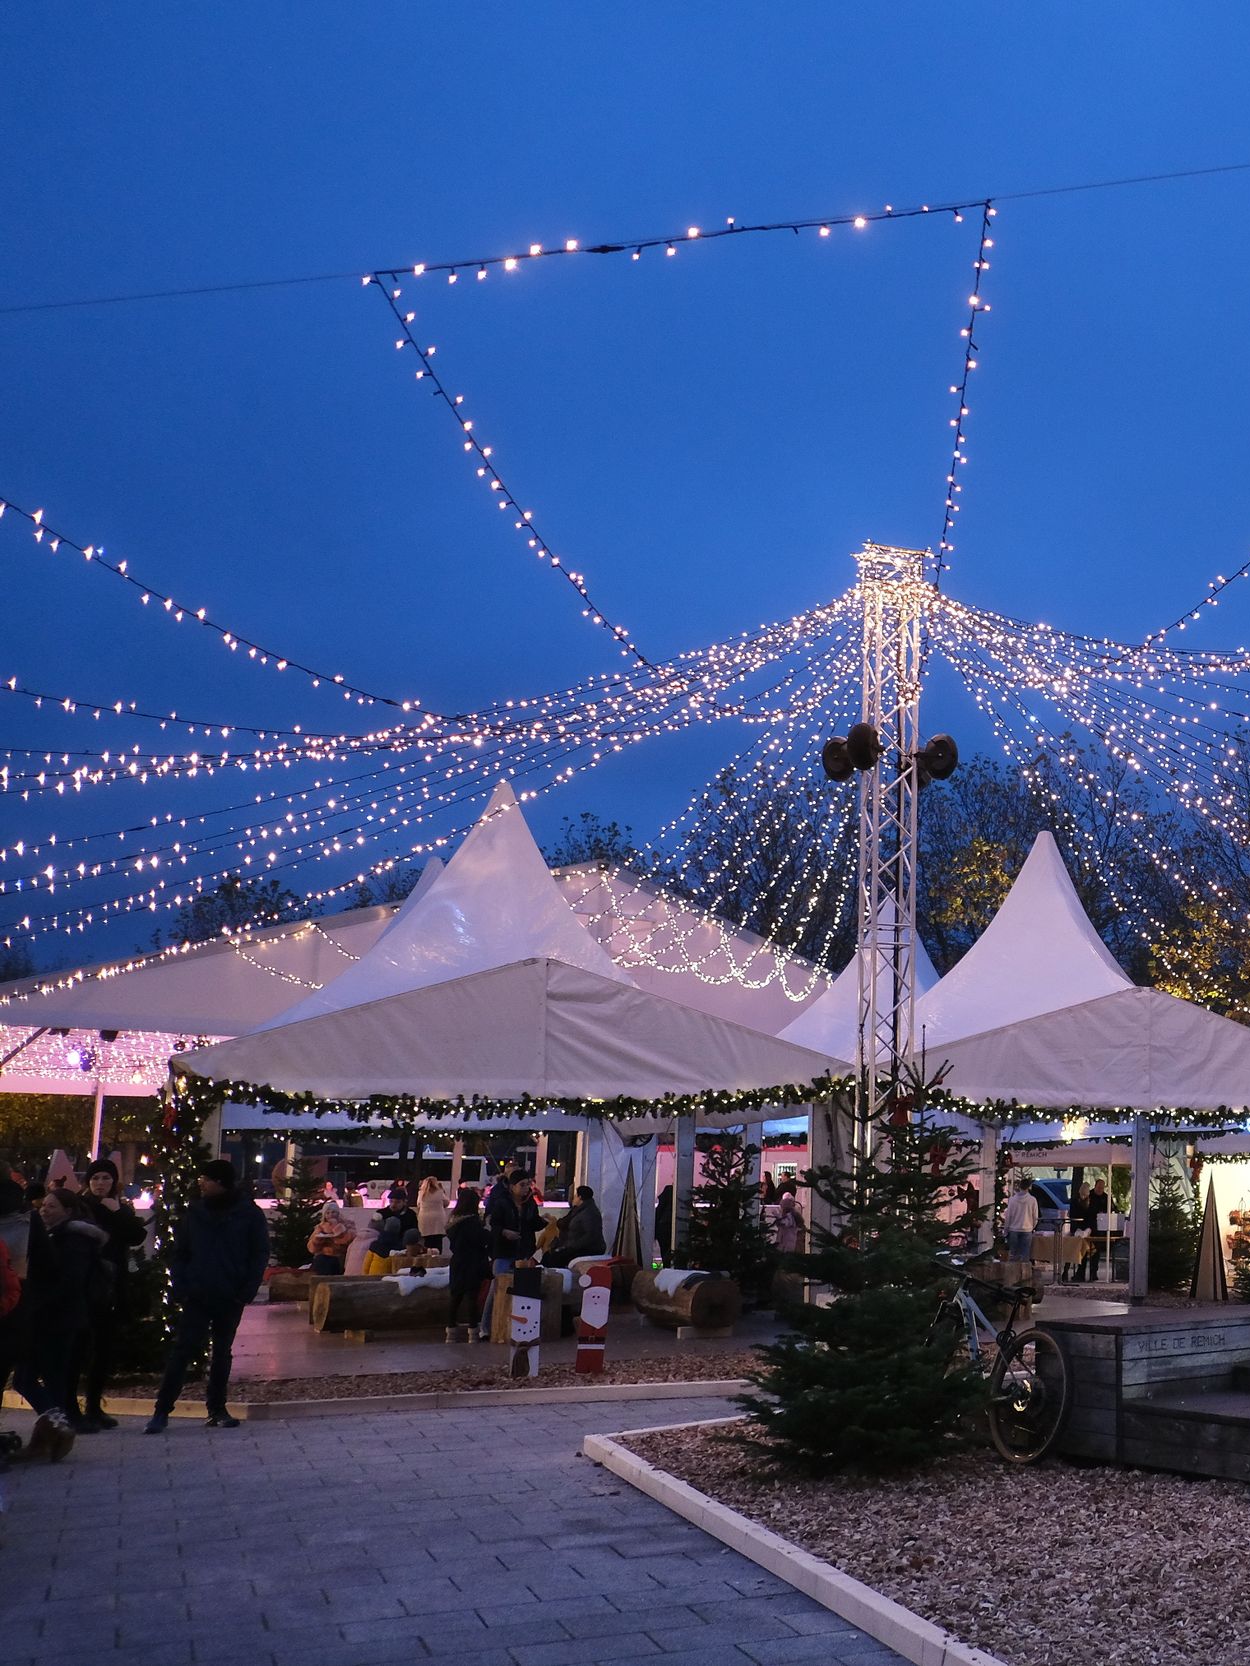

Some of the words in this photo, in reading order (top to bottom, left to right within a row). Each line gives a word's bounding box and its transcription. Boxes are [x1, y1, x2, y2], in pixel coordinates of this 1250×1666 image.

[1138, 1338, 1168, 1352] VILLE
[1173, 1337, 1186, 1350] DE
[1190, 1334, 1226, 1348] REMICH
